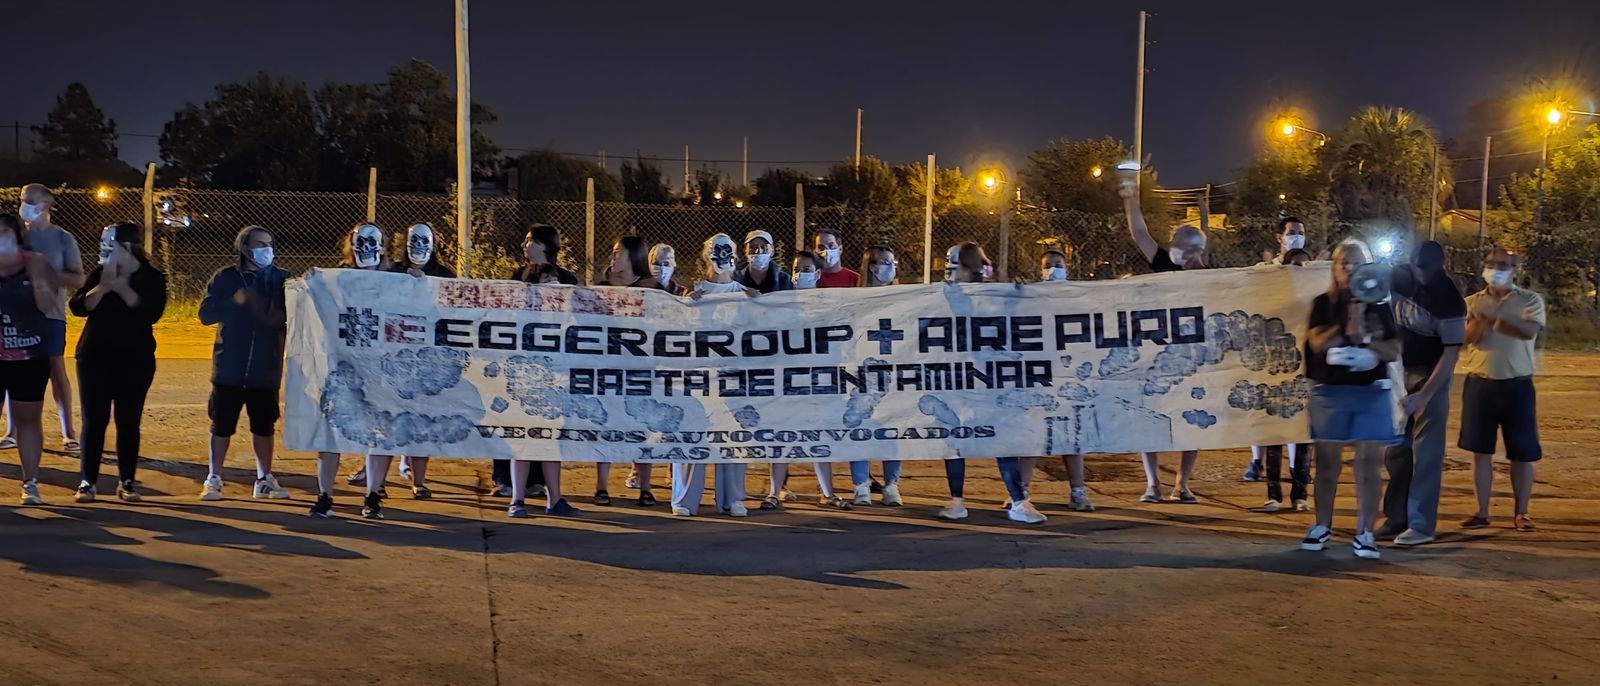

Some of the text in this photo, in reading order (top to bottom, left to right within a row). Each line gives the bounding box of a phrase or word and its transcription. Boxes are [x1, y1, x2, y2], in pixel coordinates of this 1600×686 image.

[918, 315, 1044, 353] AIRE
[1054, 306, 1206, 351] PURO
[3, 335, 41, 349] Ritmo
[569, 359, 1054, 398] BASTA DE CONTAMINAR
[474, 425, 996, 444] VECINOS AUTOCONVOCADOS
[638, 444, 832, 461] LAS TEJAS
